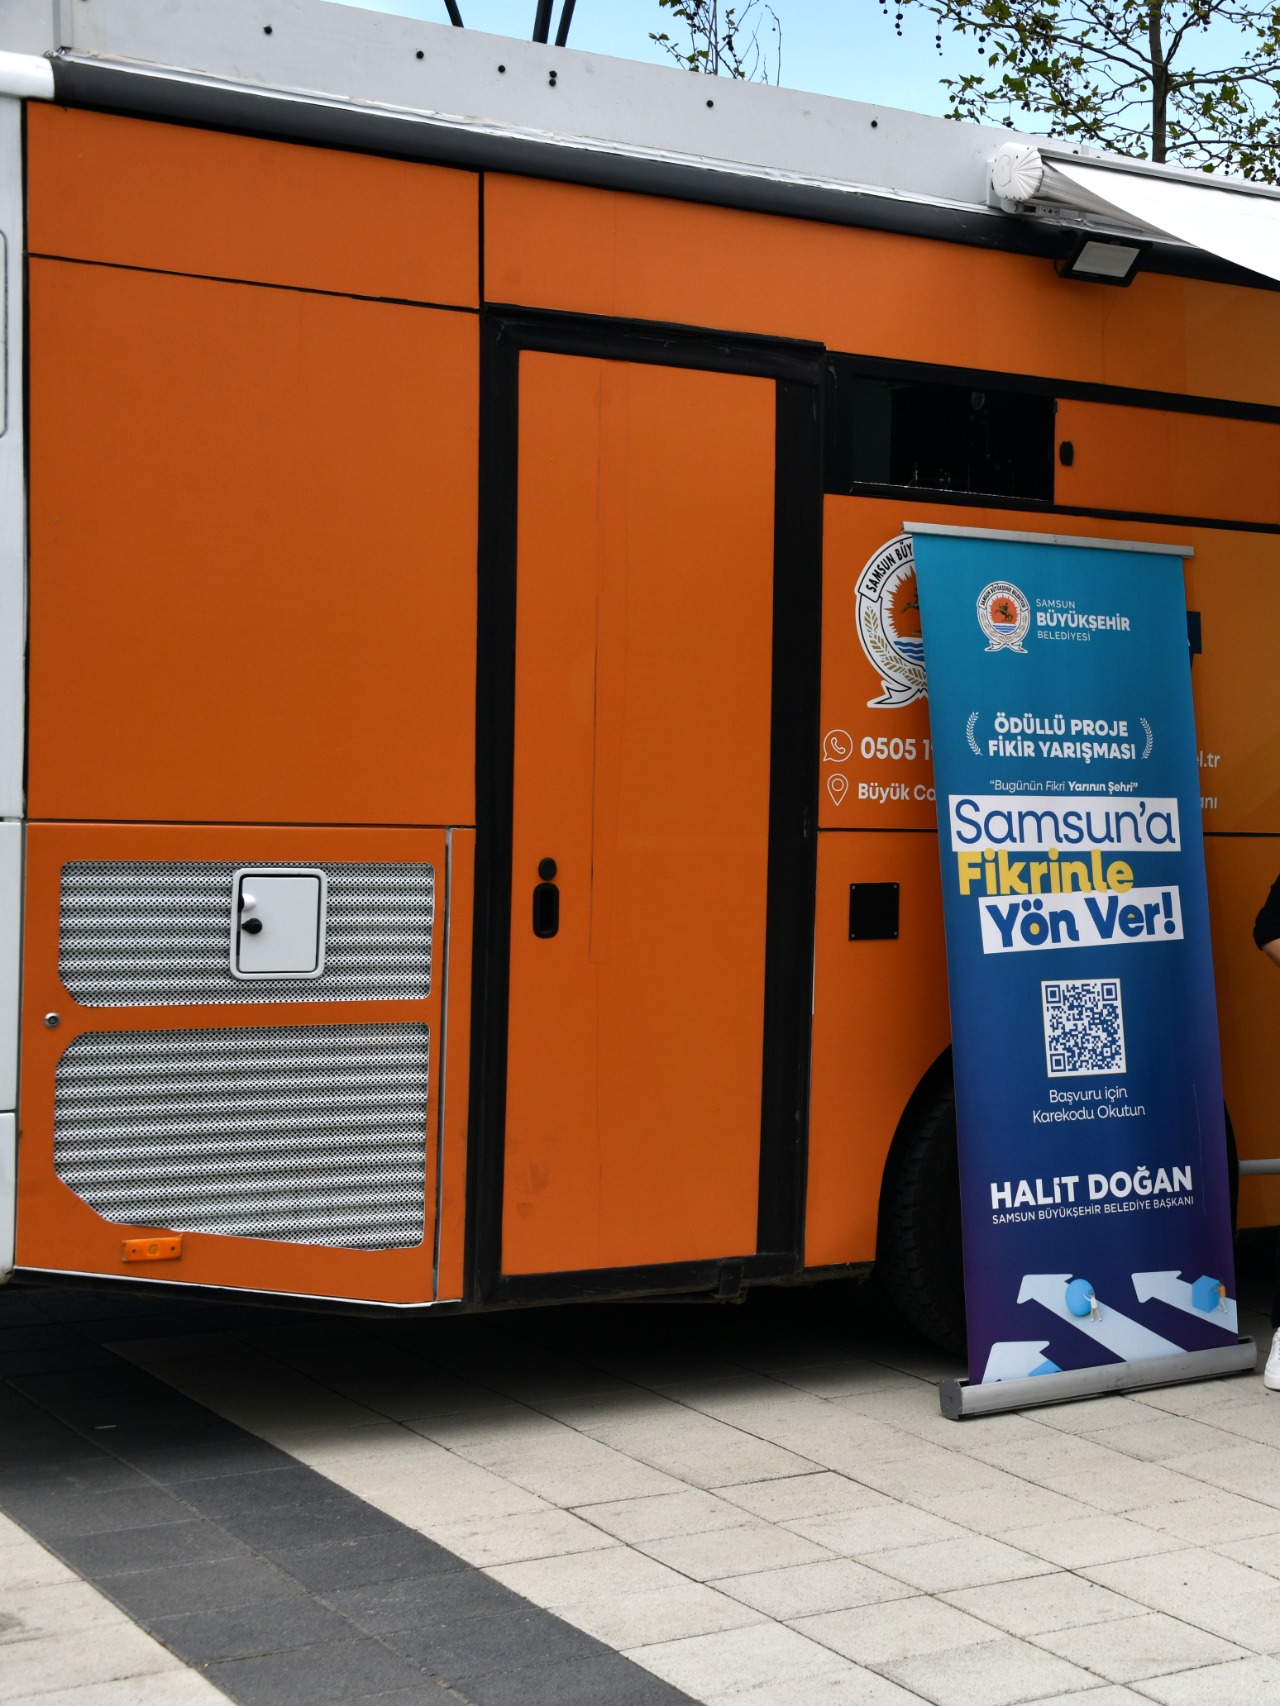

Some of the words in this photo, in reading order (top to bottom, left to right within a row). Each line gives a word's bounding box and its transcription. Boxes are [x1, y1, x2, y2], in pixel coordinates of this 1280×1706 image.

[866, 553, 896, 593] SAMSUN
[1036, 598, 1076, 608] SAMSUN
[1036, 609, 1130, 632] BÜYÜKŞEHİR
[1037, 630, 1090, 641] BELEDİYESİ
[994, 712, 1063, 737] ÖDÜLLÜ
[1070, 719, 1128, 738] PROJE
[860, 736, 917, 760] 0505
[988, 735, 1035, 759] FİKİR
[1038, 740, 1136, 763] YARIŞMASI
[858, 782, 910, 804] Büyük
[1046, 781, 1065, 791] Fikri
[1068, 781, 1106, 792] Yarının
[957, 847, 1134, 895] Fikrinle
[985, 898, 1080, 947] Yön
[1084, 892, 1176, 939] Ver!
[1049, 1087, 1102, 1105] Başvuru
[1104, 1086, 1127, 1102] için
[1033, 1109, 1094, 1123] Karekodu
[1098, 1104, 1145, 1118] Okutun
[990, 1175, 1079, 1209] HALİT
[1088, 1165, 1192, 1200] DOĞAN
[992, 1212, 1035, 1224] SAMSUN
[1038, 1203, 1101, 1219] BÜYÜKŞEHİR
[1104, 1198, 1151, 1214] BELEDİYE
[1153, 1196, 1193, 1210] BAŞKANI
